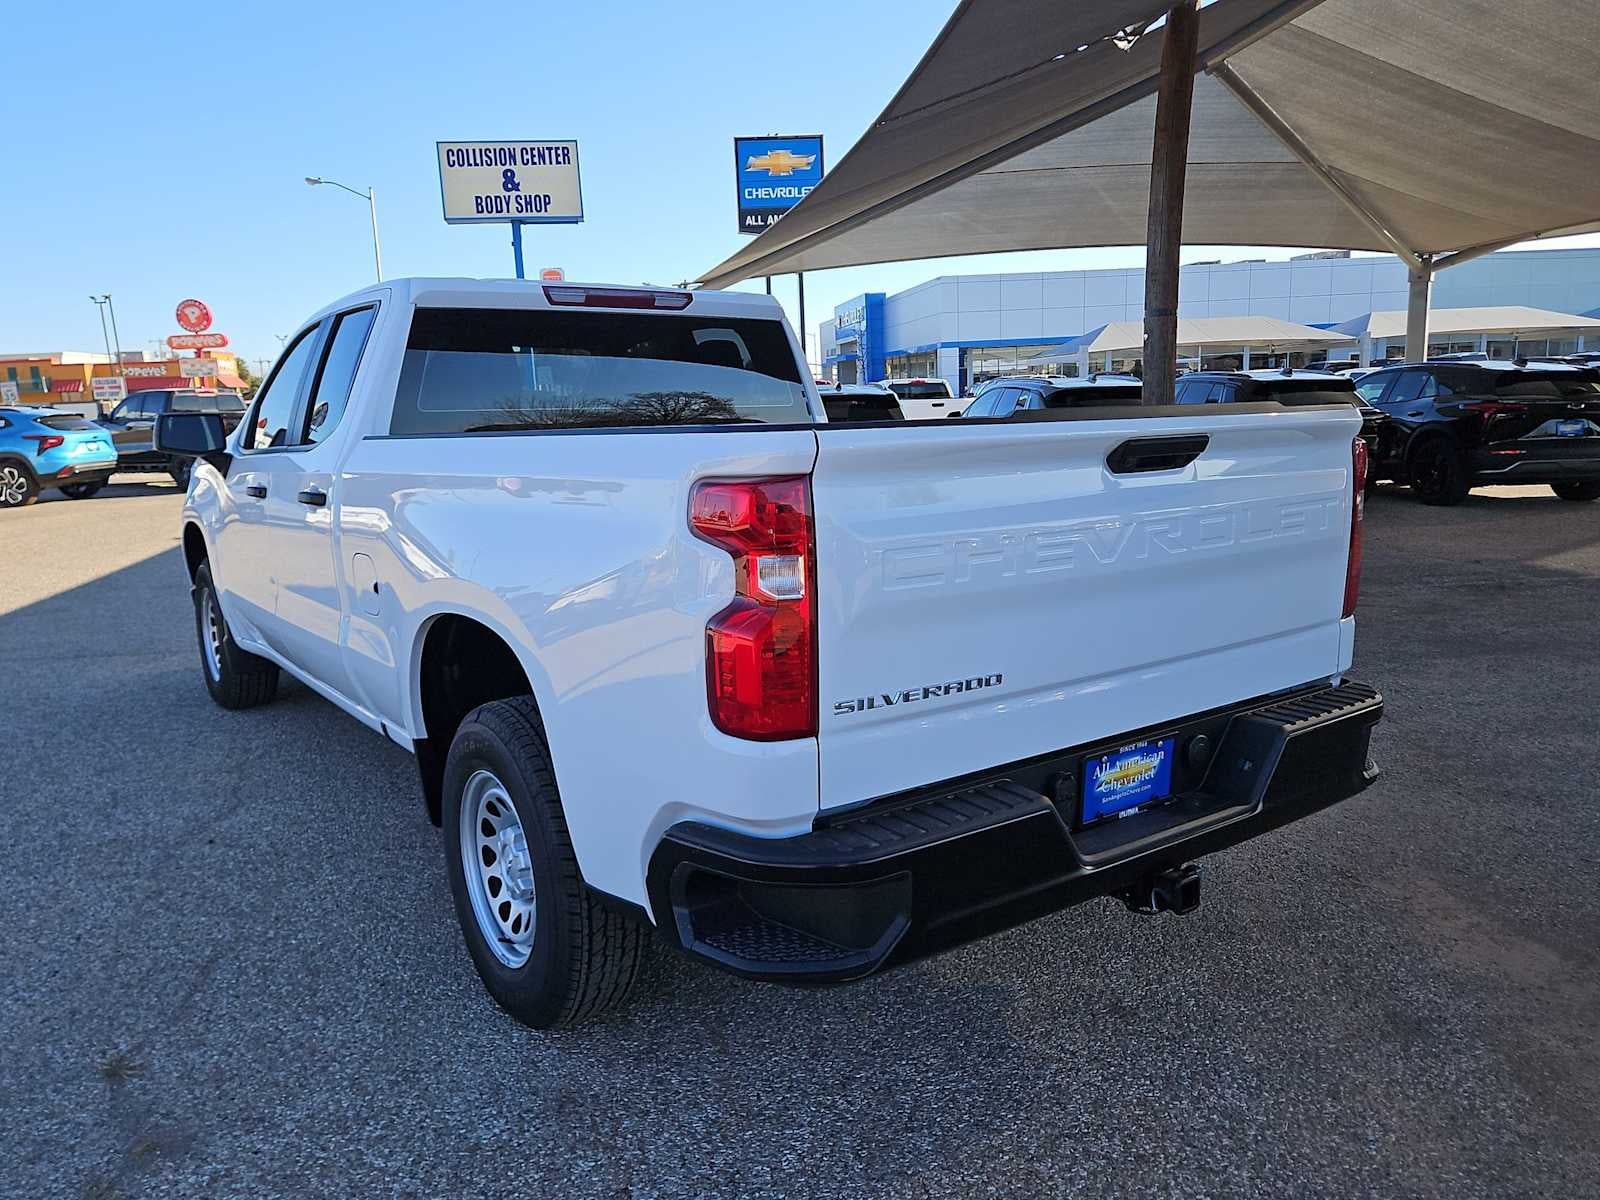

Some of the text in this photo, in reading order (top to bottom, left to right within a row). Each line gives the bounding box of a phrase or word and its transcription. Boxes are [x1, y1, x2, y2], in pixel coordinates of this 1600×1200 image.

[446, 146, 571, 168] COLLISION CENTER
[502, 168, 521, 192] &
[474, 194, 552, 214] BODY SHOP
[745, 215, 765, 226] ALL
[882, 501, 1340, 592] CHEVROLET
[833, 673, 1003, 716] SILVERADO
[1114, 750, 1165, 771] American
[1102, 769, 1155, 793] Chevrolet
